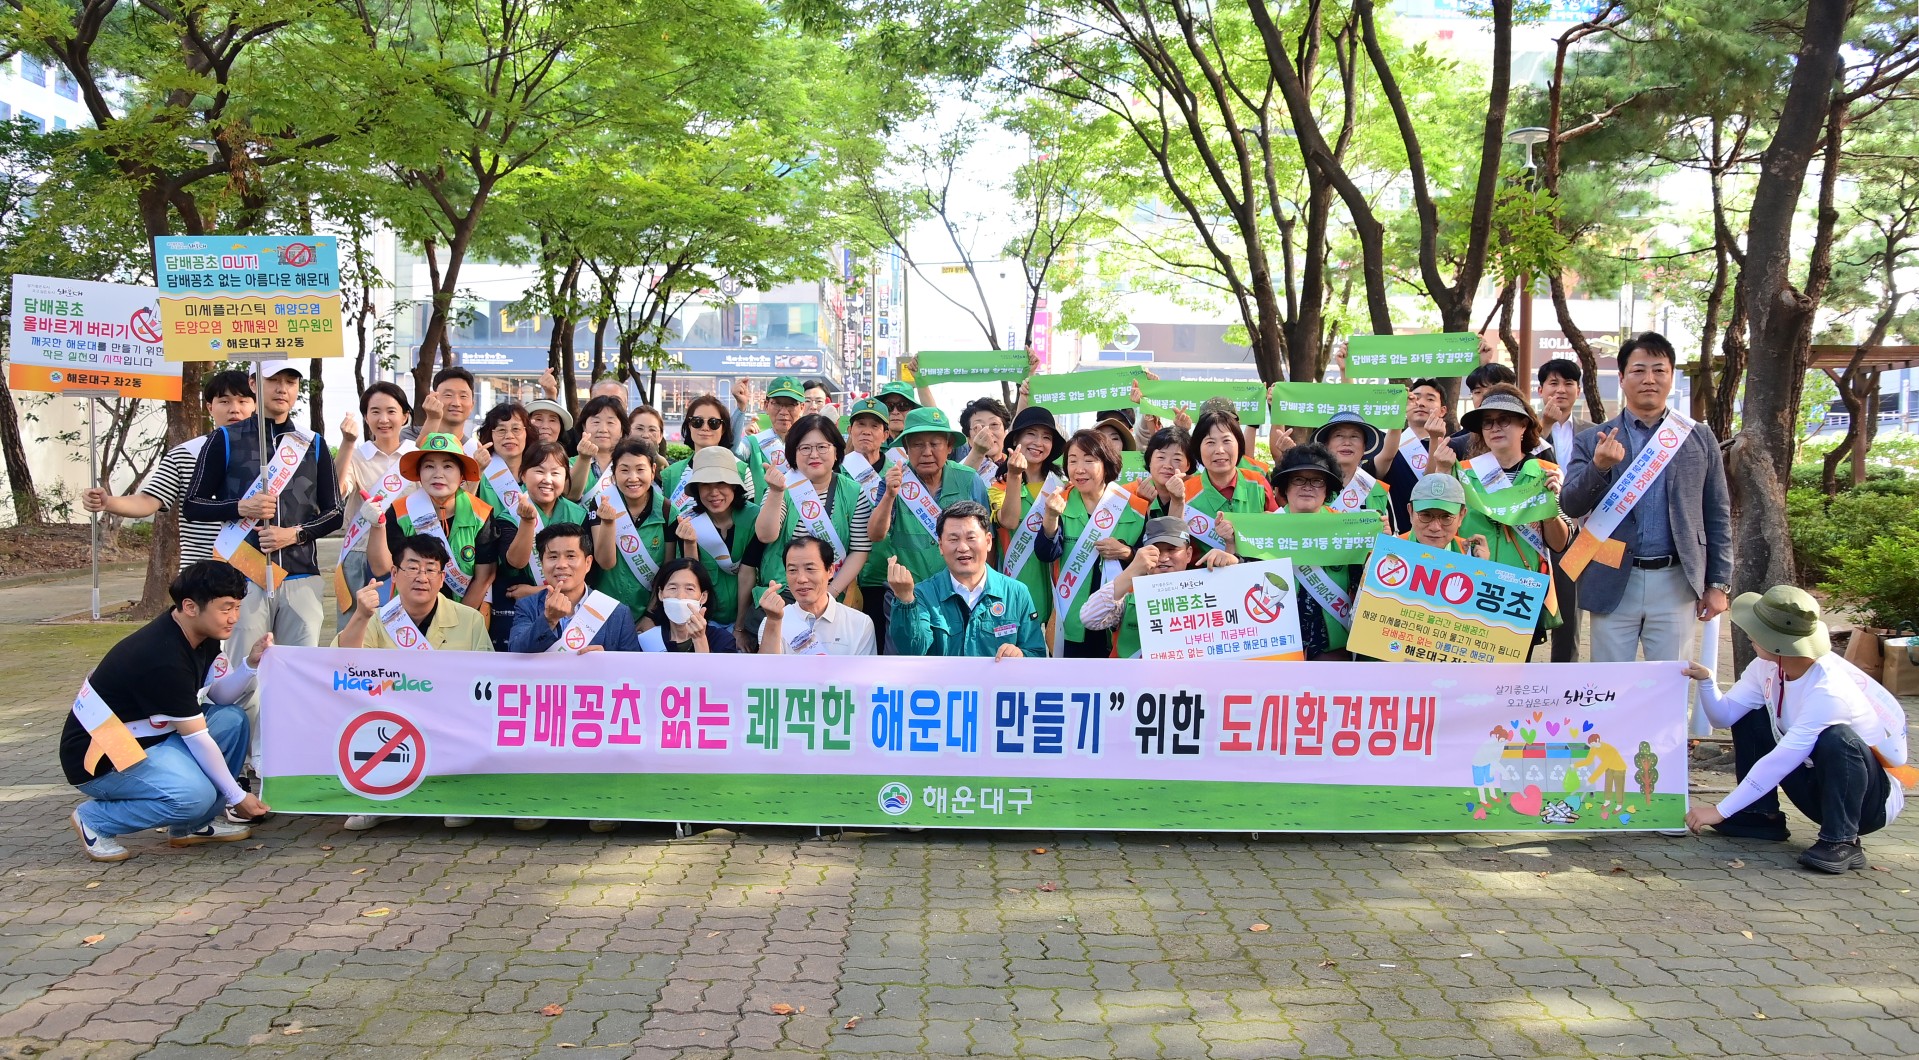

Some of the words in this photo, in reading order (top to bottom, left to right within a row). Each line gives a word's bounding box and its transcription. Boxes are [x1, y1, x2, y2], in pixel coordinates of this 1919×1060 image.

[166, 256, 218, 270] 담배꽁초
[222, 255, 259, 270] OUT!
[167, 274, 214, 288] 담배꽁초
[218, 273, 241, 287] 없는
[246, 273, 291, 287] 아름다운
[295, 273, 329, 287] 해운대
[724, 279, 740, 293] 3F
[24, 298, 84, 317] 담배꽁초
[185, 303, 266, 316] 미세플라스틱
[274, 303, 320, 315] 해양오염
[24, 316, 83, 336] 올바르게
[87, 322, 128, 339] 버리기
[175, 320, 222, 334] 토양오염
[232, 319, 278, 333] 화재원인
[287, 318, 333, 332] 침수원인
[31, 336, 61, 349] 깨끗한
[66, 339, 106, 352] 해운대를
[111, 343, 141, 354] 만들기
[146, 346, 164, 356] 위한
[227, 338, 271, 349] 해운대구
[275, 337, 304, 348] 좌2동
[42, 349, 63, 361] 작은
[68, 351, 98, 363] 실천의
[102, 354, 153, 367] 시작입니다
[1351, 354, 1387, 365] 담배꽁초
[1390, 354, 1408, 365] 없는
[1410, 352, 1433, 364] 좌1동
[1435, 352, 1474, 364] 청결맛집
[67, 373, 110, 386] 해운대구
[114, 376, 142, 388] 좌2동
[1034, 392, 1066, 404] 담배꽁초
[1068, 391, 1085, 401] 없는
[1087, 388, 1108, 399] 좌1동
[1110, 386, 1132, 397] 청결
[1148, 399, 1177, 410] 배꽁초
[1233, 401, 1259, 412] 결맛집
[1280, 400, 1314, 413] 담배꽁초
[1317, 403, 1335, 415] 없는
[1363, 403, 1400, 416] 청결맛집
[1633, 449, 1669, 492] 담배꽁초
[268, 467, 291, 496] 담배
[1617, 472, 1636, 493] 해운대
[919, 496, 941, 519] 담배
[1614, 491, 1637, 515] 없는
[1007, 531, 1033, 571] 담배꽁초
[1069, 529, 1102, 574] 담배꽁초
[1278, 537, 1299, 550] 없는
[1302, 537, 1328, 549] 좌1동
[1331, 536, 1375, 550] 청결맛집
[631, 553, 655, 583] 담배꽁
[1299, 565, 1337, 604] 담배꽁초
[1147, 593, 1217, 615] 담배꽁초는
[1476, 581, 1535, 621] 꽁초
[1150, 618, 1163, 634] 꼭
[1169, 609, 1239, 632] 쓰레기통에
[1362, 610, 1376, 621] 해양
[1432, 627, 1448, 639] 되어
[1450, 632, 1472, 646] 물고기
[1474, 638, 1496, 651] 먹이가
[1400, 608, 1424, 621] 바다로
[1454, 621, 1489, 638] 담배꽁초!
[1185, 634, 1214, 645] 나부터!
[1221, 627, 1258, 641] 지금부터!
[1188, 647, 1204, 658] 없는
[1207, 641, 1241, 655] 아름다운
[1243, 638, 1268, 650] 해운대
[1270, 634, 1295, 647] 만들기
[1381, 627, 1414, 642] 담배꽁초
[1417, 635, 1432, 648] 없는
[1435, 641, 1468, 655] 아름다운
[1470, 650, 1495, 663] 해운대
[1405, 644, 1448, 663] 해운대구
[333, 670, 433, 696] Haeundae
[348, 667, 400, 678] Sun&Fun
[660, 685, 730, 749] 없는
[746, 686, 855, 751] 쾌적한
[871, 686, 978, 753] 해운대
[1135, 690, 1205, 755] 위한
[1219, 692, 1436, 756] 도시환경정비
[922, 785, 1033, 815] 해운대구
